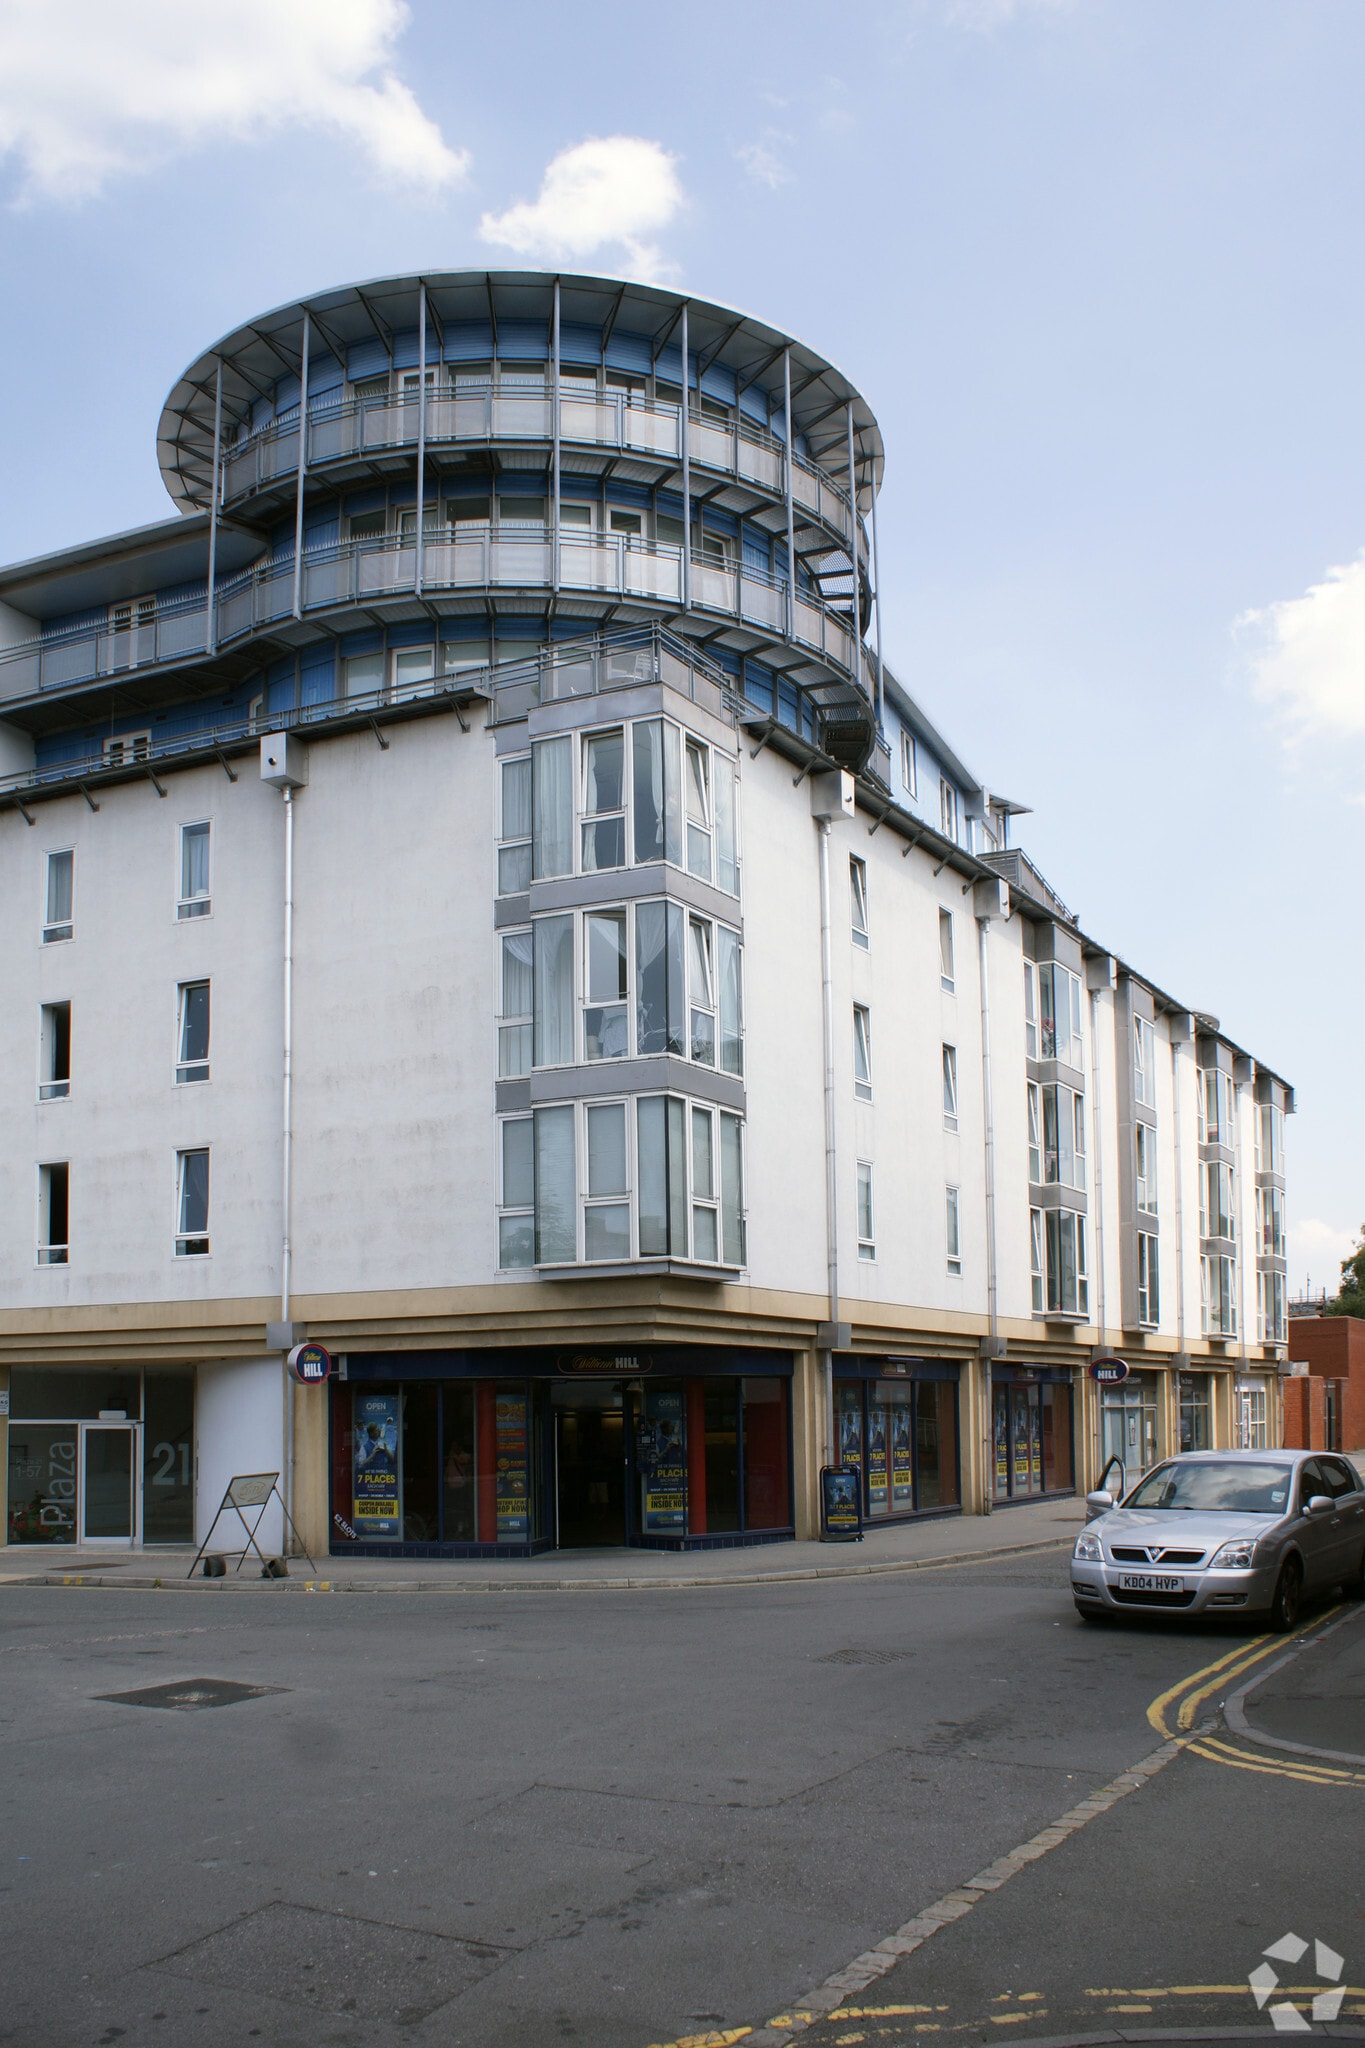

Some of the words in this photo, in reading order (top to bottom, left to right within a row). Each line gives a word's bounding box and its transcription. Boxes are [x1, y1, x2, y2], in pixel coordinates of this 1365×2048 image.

[615, 1357, 640, 1369] HILL
[303, 1363, 323, 1377] HILL
[1097, 1370, 1118, 1379] HILL
[366, 1402, 387, 1410] OPEN
[657, 1399, 680, 1407] OPEN
[152, 1442, 190, 1486] 21
[16, 1465, 42, 1478] 1-57
[40, 1441, 76, 1526] Plaza
[357, 1474, 363, 1484] 7
[364, 1474, 396, 1484] PLACES
[651, 1500, 672, 1508] INSIDE
[358, 1506, 379, 1515] INSIDE
[380, 1506, 394, 1515] NOW
[341, 1520, 358, 1539] SLOTS
